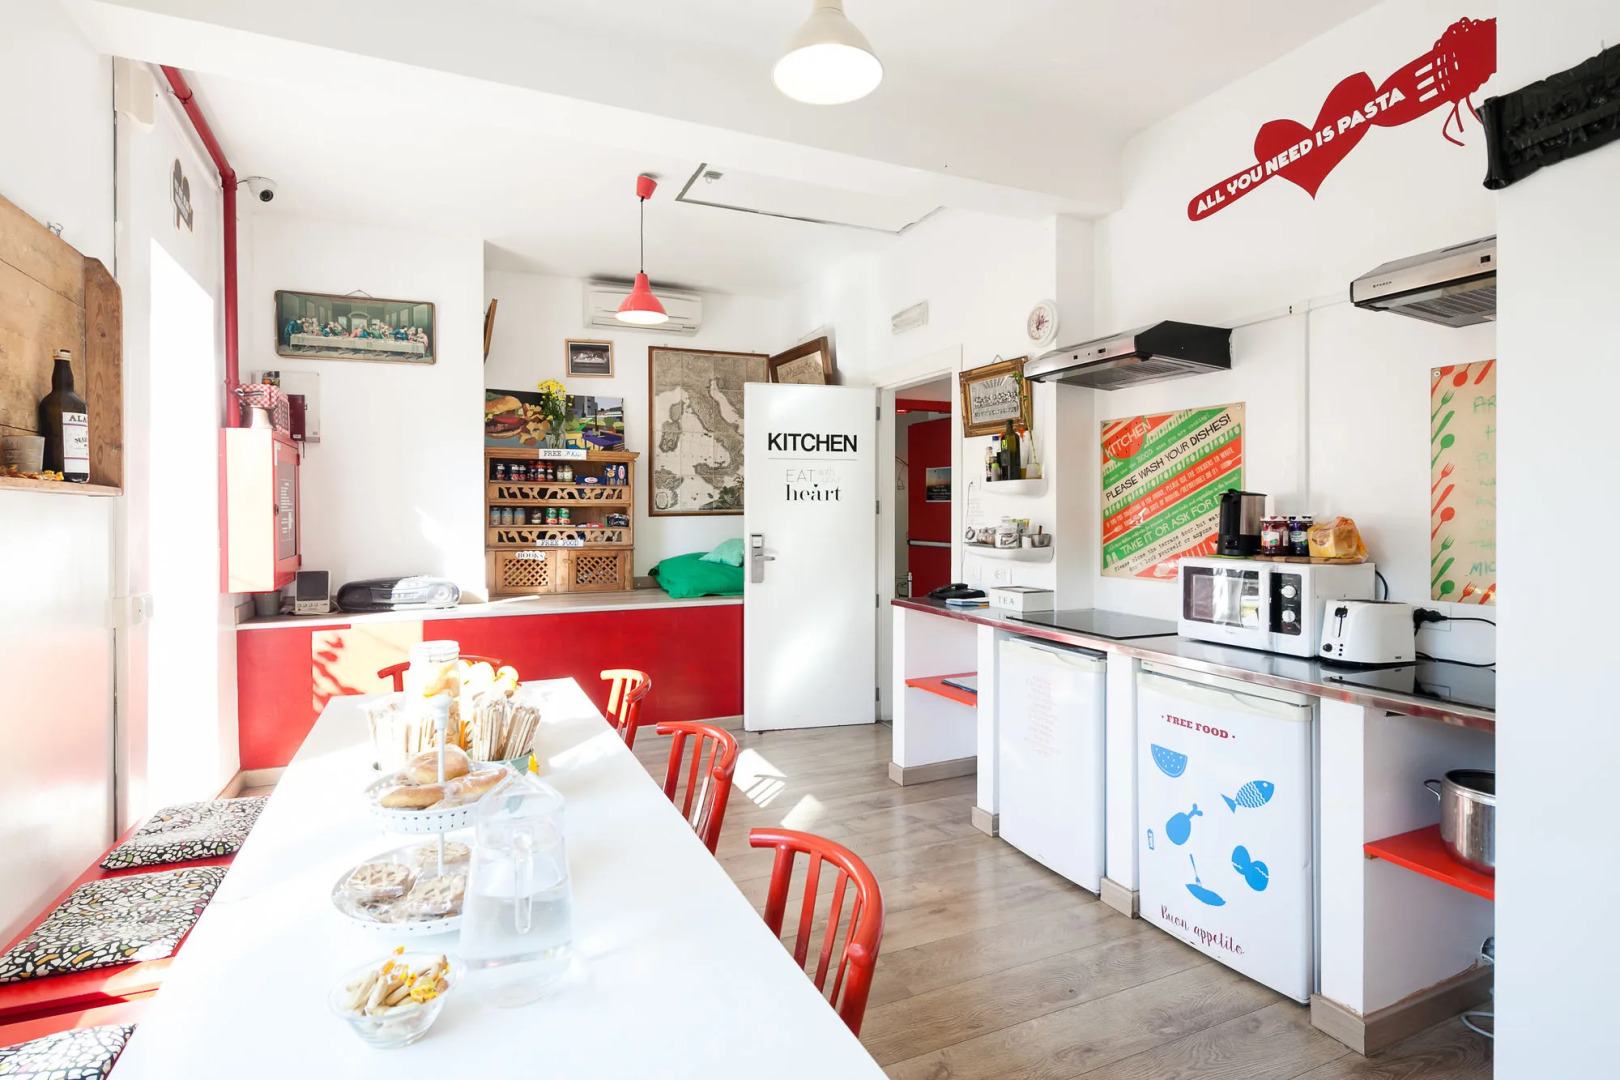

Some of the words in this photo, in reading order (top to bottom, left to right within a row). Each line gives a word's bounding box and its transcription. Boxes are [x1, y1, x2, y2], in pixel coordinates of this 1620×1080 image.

[1196, 189, 1225, 215] ALL
[1227, 164, 1263, 196] YOU
[1265, 138, 1314, 176] NEED
[1315, 125, 1335, 147] IS
[1337, 87, 1406, 135] PASTA
[768, 432, 858, 453] KITCHEN
[1105, 419, 1151, 458] KITCHEN
[1106, 475, 1138, 502] PLEASE
[1138, 457, 1165, 480] WASH
[1165, 441, 1190, 462] YOUR
[1191, 413, 1232, 447] DISHES!
[1136, 448, 1153, 464] HOOD
[786, 469, 815, 483] EAT
[1165, 477, 1179, 494] PLEASE
[786, 484, 842, 502] heart
[1121, 537, 1144, 556] TAKE
[1143, 530, 1154, 546] IT
[1154, 521, 1170, 538] OR
[1170, 511, 1190, 530] ASK
[1190, 497, 1212, 518] FOR
[1147, 547, 1156, 557] the
[1158, 534, 1179, 552] terrace
[1158, 541, 1182, 560] yourself
[1183, 536, 1191, 545] or
[1192, 524, 1213, 542] anyone
[998, 595, 1015, 604] TEA
[1166, 714, 1193, 729] FREE
[1195, 721, 1229, 739] FOOD
[1161, 904, 1190, 931] Buon
[1193, 922, 1245, 955] appetito
